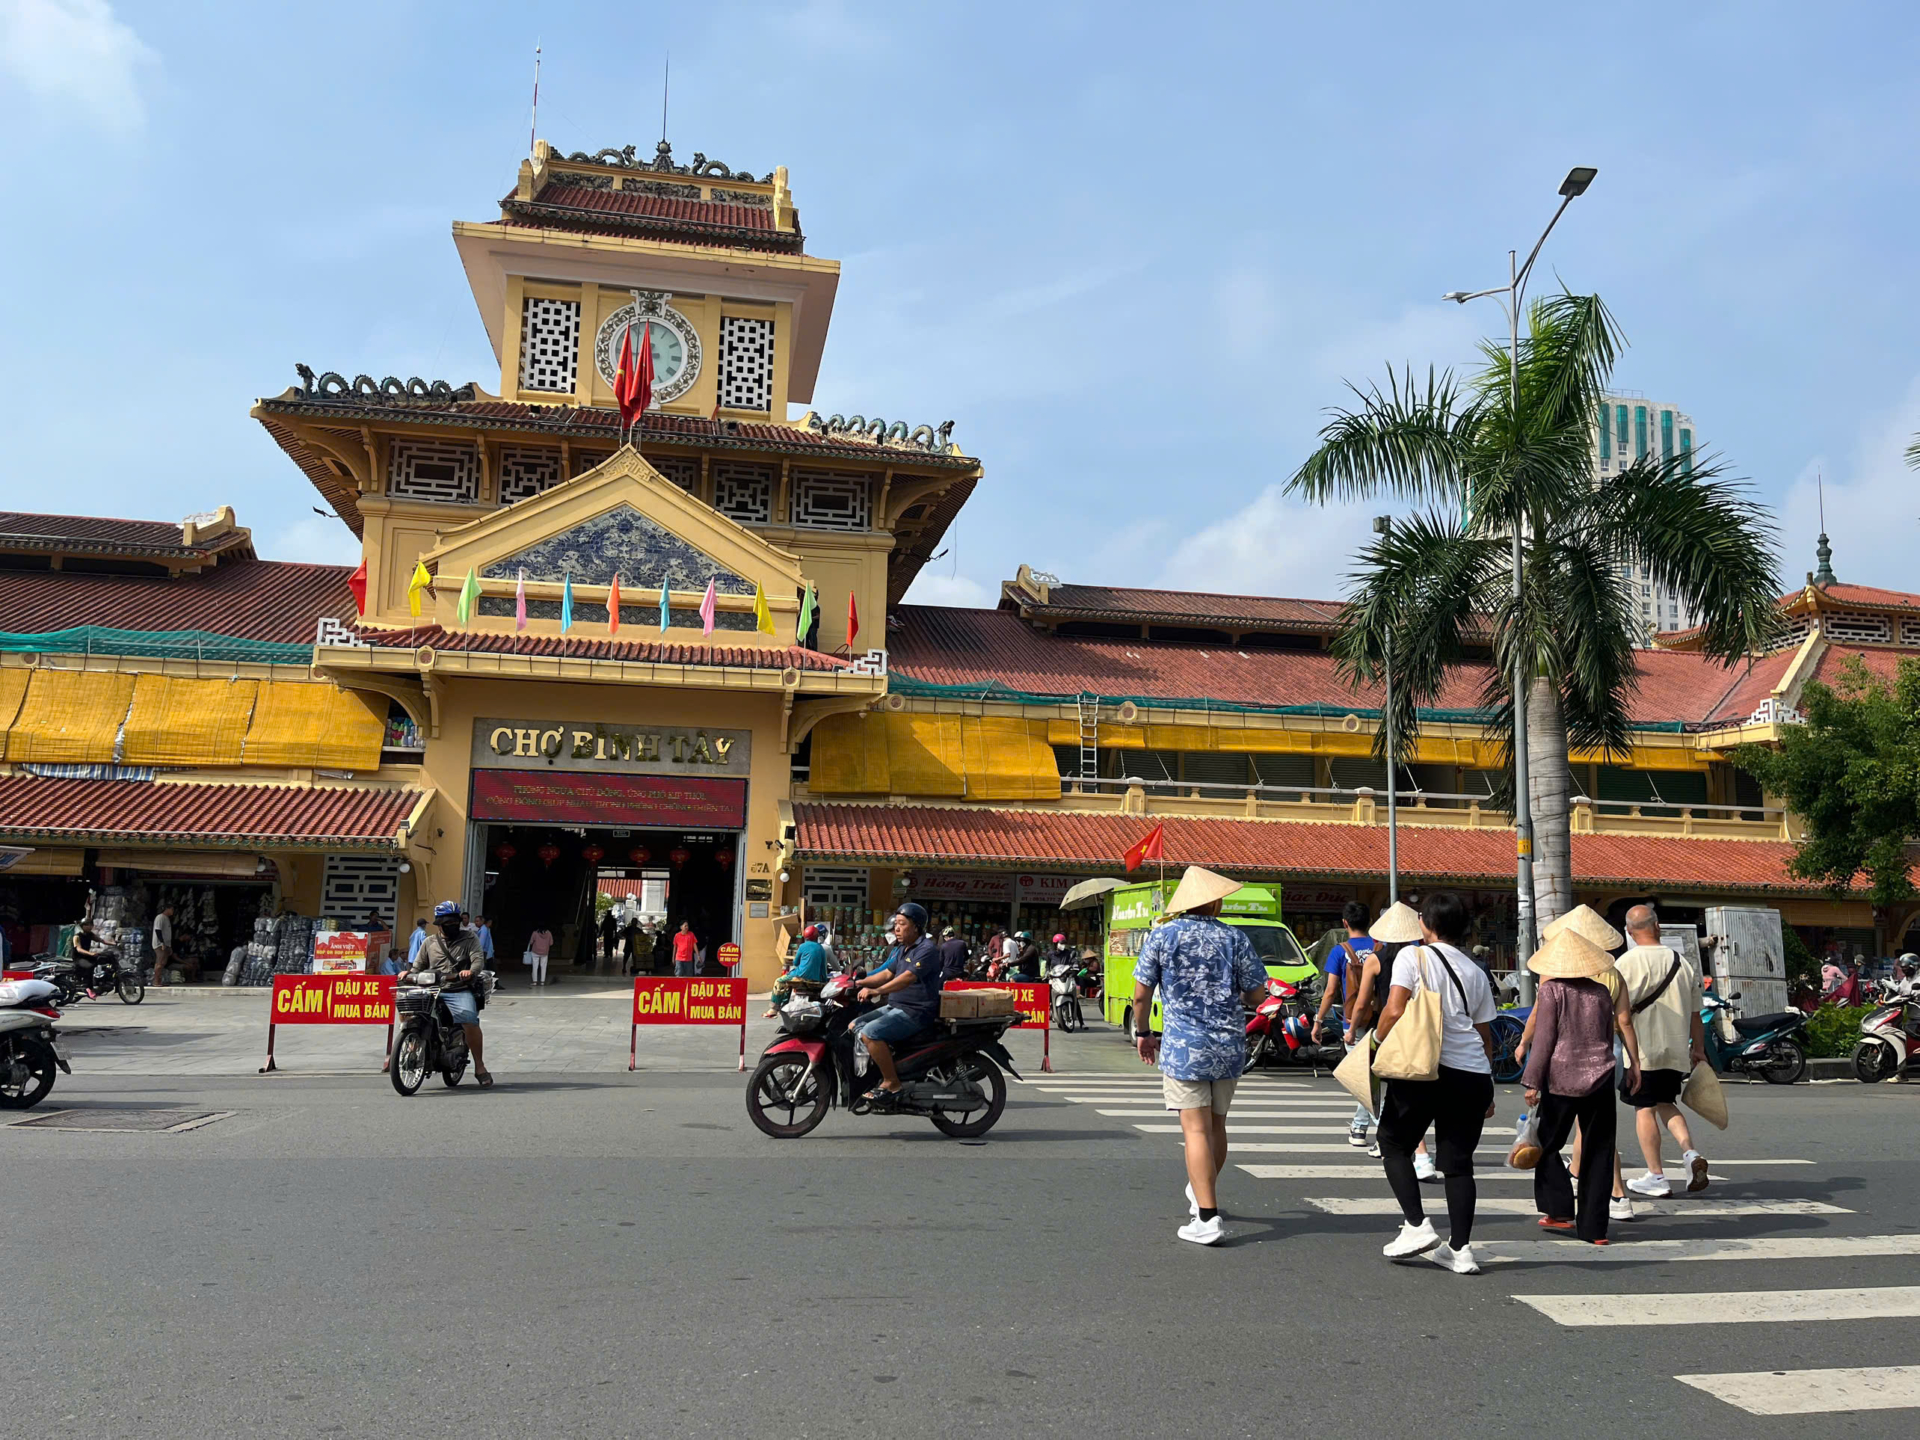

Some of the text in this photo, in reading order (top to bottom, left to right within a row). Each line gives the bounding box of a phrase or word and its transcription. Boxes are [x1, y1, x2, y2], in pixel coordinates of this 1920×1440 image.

[490, 723, 735, 765] CHỢ BÌNH TÂY
[924, 877, 1009, 891] Hồng Trúc
[1040, 878, 1068, 888] KIM
[277, 981, 324, 1013] CẤM
[335, 979, 380, 998] ĐẬU XE
[690, 981, 731, 1000] ĐẬU XE
[1021, 989, 1035, 1002] XE
[638, 983, 681, 1014] CẤM
[333, 1002, 390, 1018] MUA BÁN
[690, 1003, 742, 1019] MUA BÁN
